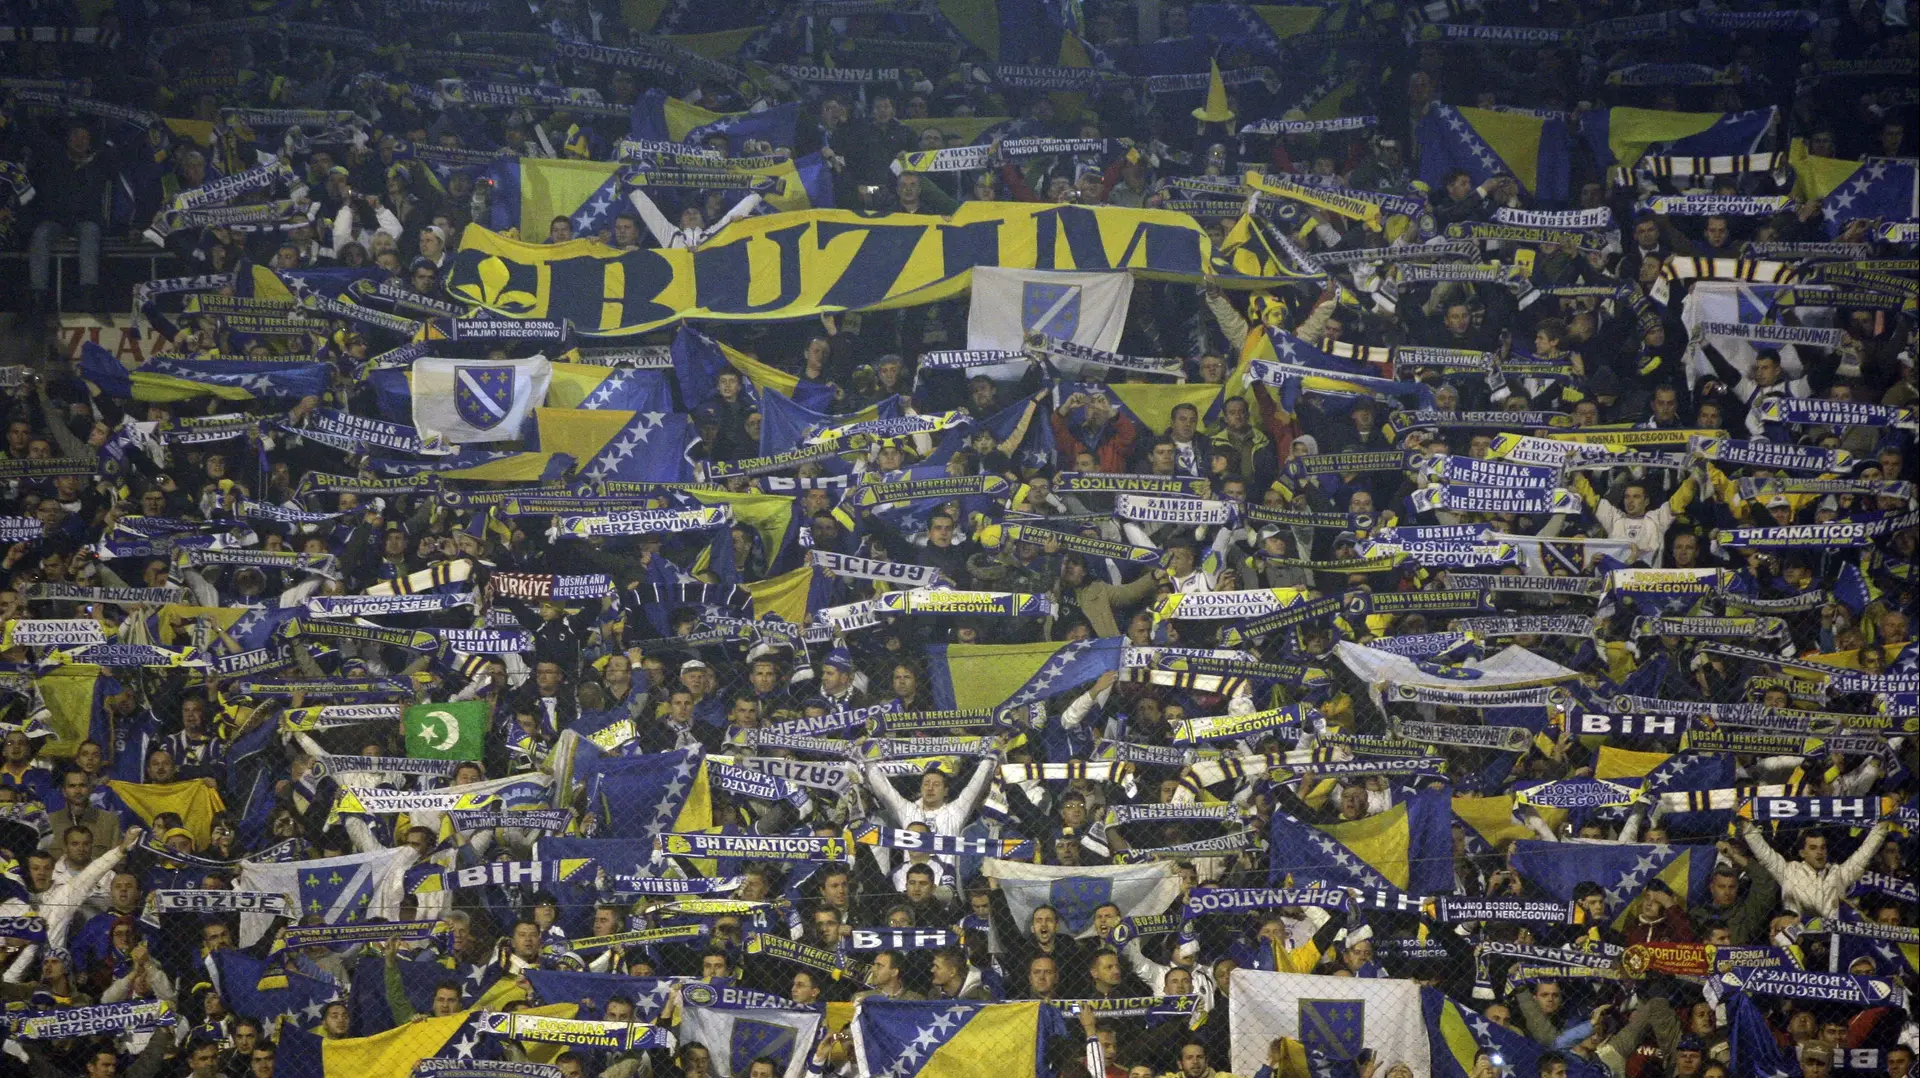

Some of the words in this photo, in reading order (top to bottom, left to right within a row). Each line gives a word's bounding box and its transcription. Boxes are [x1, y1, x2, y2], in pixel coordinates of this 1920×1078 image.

[1472, 27, 1559, 41] FANATICOS
[1667, 201, 1773, 213] HERZEGOVINA
[458, 321, 487, 329] HAJMO
[501, 330, 559, 338] HERCEGOVINO
[1711, 323, 1750, 336] BOSNIA
[1755, 325, 1831, 344] HERZEGOVINA
[338, 414, 396, 434] BOSNIA&
[1461, 411, 1547, 424] HERZEGOVINA
[319, 417, 411, 447] HERZEGOVINA
[1623, 431, 1685, 443] HERCEGOVINA
[1729, 447, 1825, 468] HERZEGOVINA
[1472, 460, 1529, 475] BOSNIA&
[317, 474, 337, 486] BH
[340, 475, 429, 488] FANATICOS
[1072, 478, 1150, 491] FANATICOS
[1453, 468, 1546, 488] HERZEGOVINA
[1156, 480, 1182, 492] BH
[1467, 487, 1526, 499] BOSNIA&
[1451, 497, 1543, 512] HERZEGOVINA
[608, 510, 678, 523] BOSNIA&
[590, 519, 701, 535] HERZEGOVINA
[1417, 526, 1475, 538] BOSNIA&
[1740, 527, 1766, 538] BH
[1768, 524, 1863, 538] FANATICOS
[1402, 541, 1473, 553] BOSNIA&
[204, 552, 293, 567] HERZEGOVINA
[827, 553, 925, 580] GAZIJE
[560, 576, 588, 586] BOSNIA
[590, 575, 605, 584] AND
[1505, 576, 1577, 590] HERZEGOVINA
[1622, 581, 1709, 593] HERZEGOVINA
[56, 585, 94, 599] BOSNIA
[98, 587, 171, 602] HERZEGOVINA
[553, 585, 609, 596] HERZEGOVINA
[1413, 591, 1478, 602] HERCEGOVINA
[1196, 594, 1263, 605] BOSNIA&
[917, 602, 1006, 614] HERZEGOVINA
[1178, 604, 1284, 618] HERZEGOVINA
[27, 622, 90, 634] BOSNIA&
[440, 629, 500, 641] BOSNIA&
[1665, 624, 1753, 635] HERZEGOVINA
[91, 645, 153, 655] BOSNIA&
[72, 655, 172, 666] HERZEGOVINA
[926, 708, 992, 719] HERCEGOVINA
[1202, 713, 1293, 738] HERZEGOVINA
[1582, 714, 1675, 734] BiH
[760, 733, 844, 752] HERZEGOVINA
[1692, 730, 1725, 742] BOSNA
[1733, 734, 1801, 746] HERCEGOVINA
[336, 757, 373, 772] BOSNIA
[377, 757, 449, 773] HERZEGOVINA
[1326, 760, 1430, 772] FANATICOS
[1544, 783, 1611, 795] BOSNIA&
[1526, 792, 1632, 806] HERZEGOVINA
[1130, 807, 1225, 819] HERZEGOVINA
[1769, 799, 1863, 818] BiH
[500, 818, 562, 830] HERCEGOVINO
[696, 837, 718, 849] BH
[724, 838, 820, 852] FANATICOS
[458, 861, 542, 887] BiH
[173, 896, 276, 908] GAZIJE
[1191, 889, 1343, 912] BHFANATICOS
[1448, 902, 1482, 911] HAJMO
[1495, 911, 1565, 922] HERCEGOVINO
[763, 936, 796, 951] BOSNA
[854, 929, 945, 948] BiH
[1483, 943, 1585, 965] FANATICOS
[1647, 947, 1705, 962] PORTUGAL
[1729, 950, 1764, 959] BOSNIA
[58, 1004, 131, 1021] BOSNIA&
[37, 1013, 155, 1037] HERZEGOVINA
[522, 1030, 618, 1047] HERZEGOVINA
[420, 1060, 465, 1073] BOSNIA
